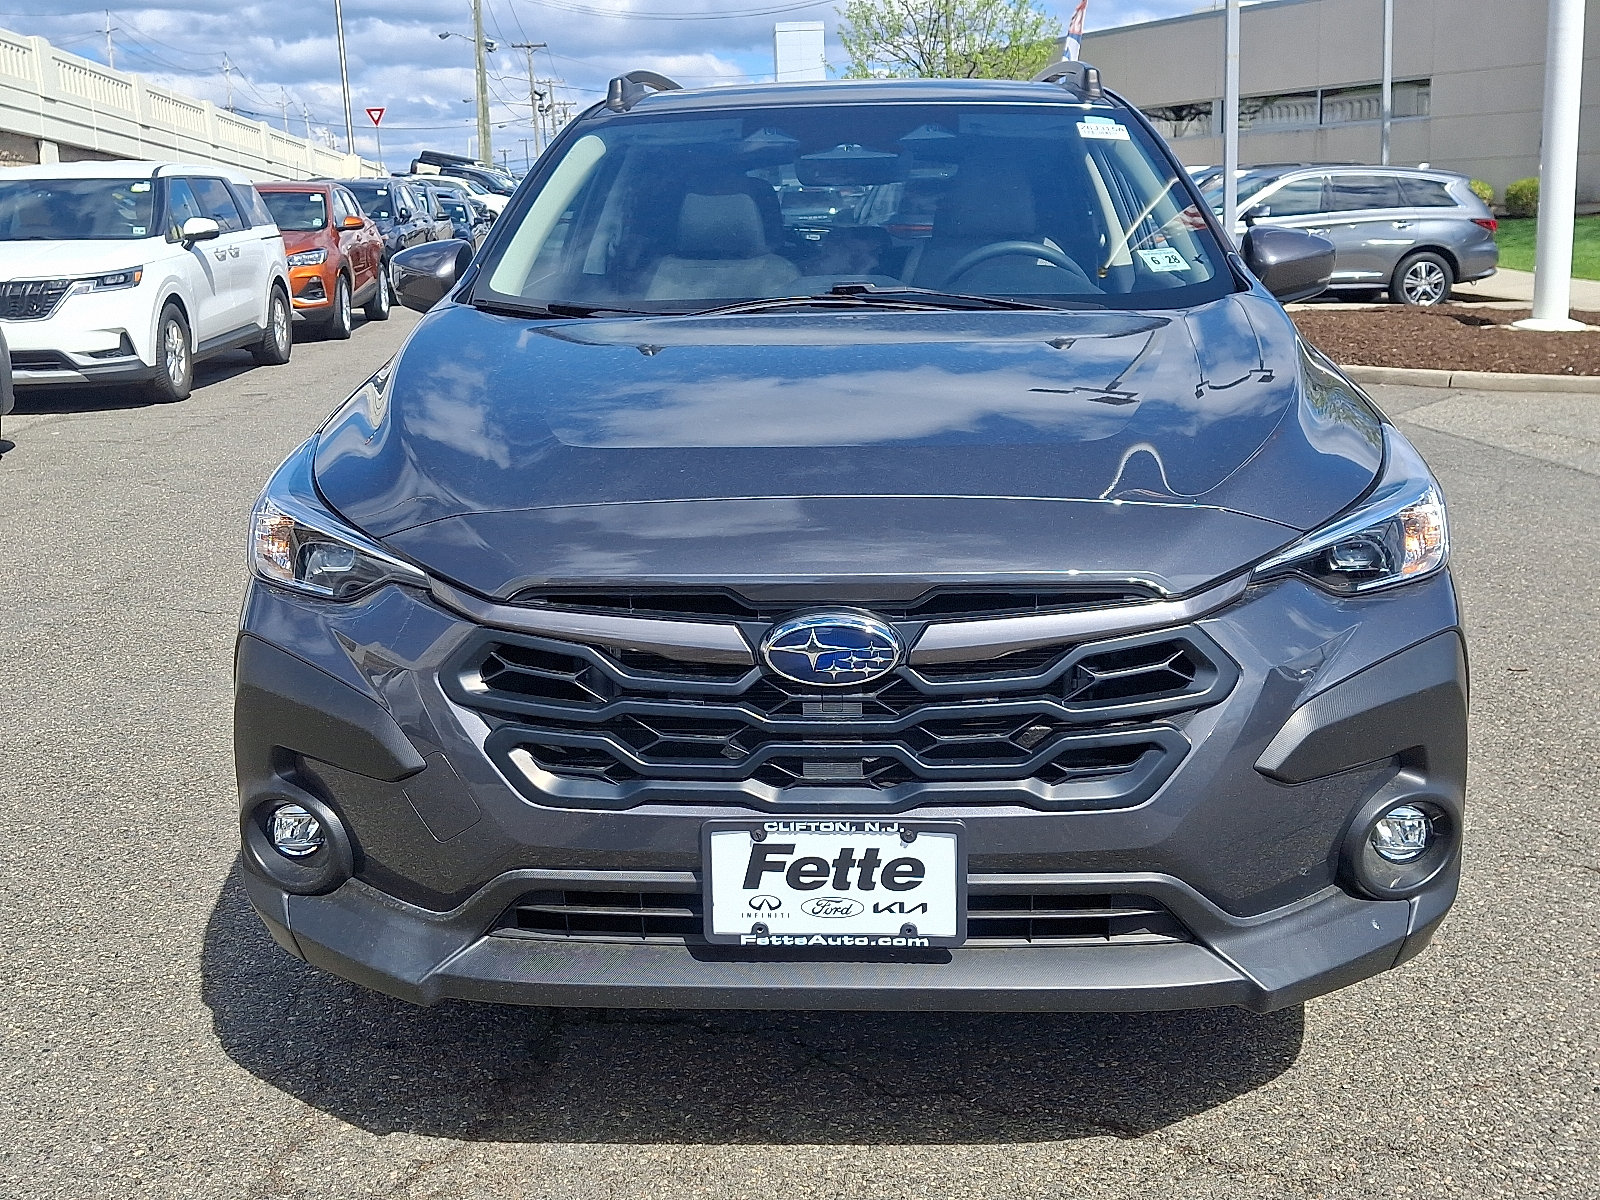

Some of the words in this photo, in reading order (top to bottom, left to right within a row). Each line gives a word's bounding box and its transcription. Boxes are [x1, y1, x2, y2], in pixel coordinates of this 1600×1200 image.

[1150, 256, 1161, 265] 6
[1164, 254, 1181, 264] 28
[763, 821, 857, 833] CLIFTON,
[864, 821, 905, 833] N.J.
[742, 843, 926, 892] Fette
[810, 897, 854, 916] Ford
[873, 901, 928, 915] KIA
[741, 934, 930, 947] FetteAuto.com
